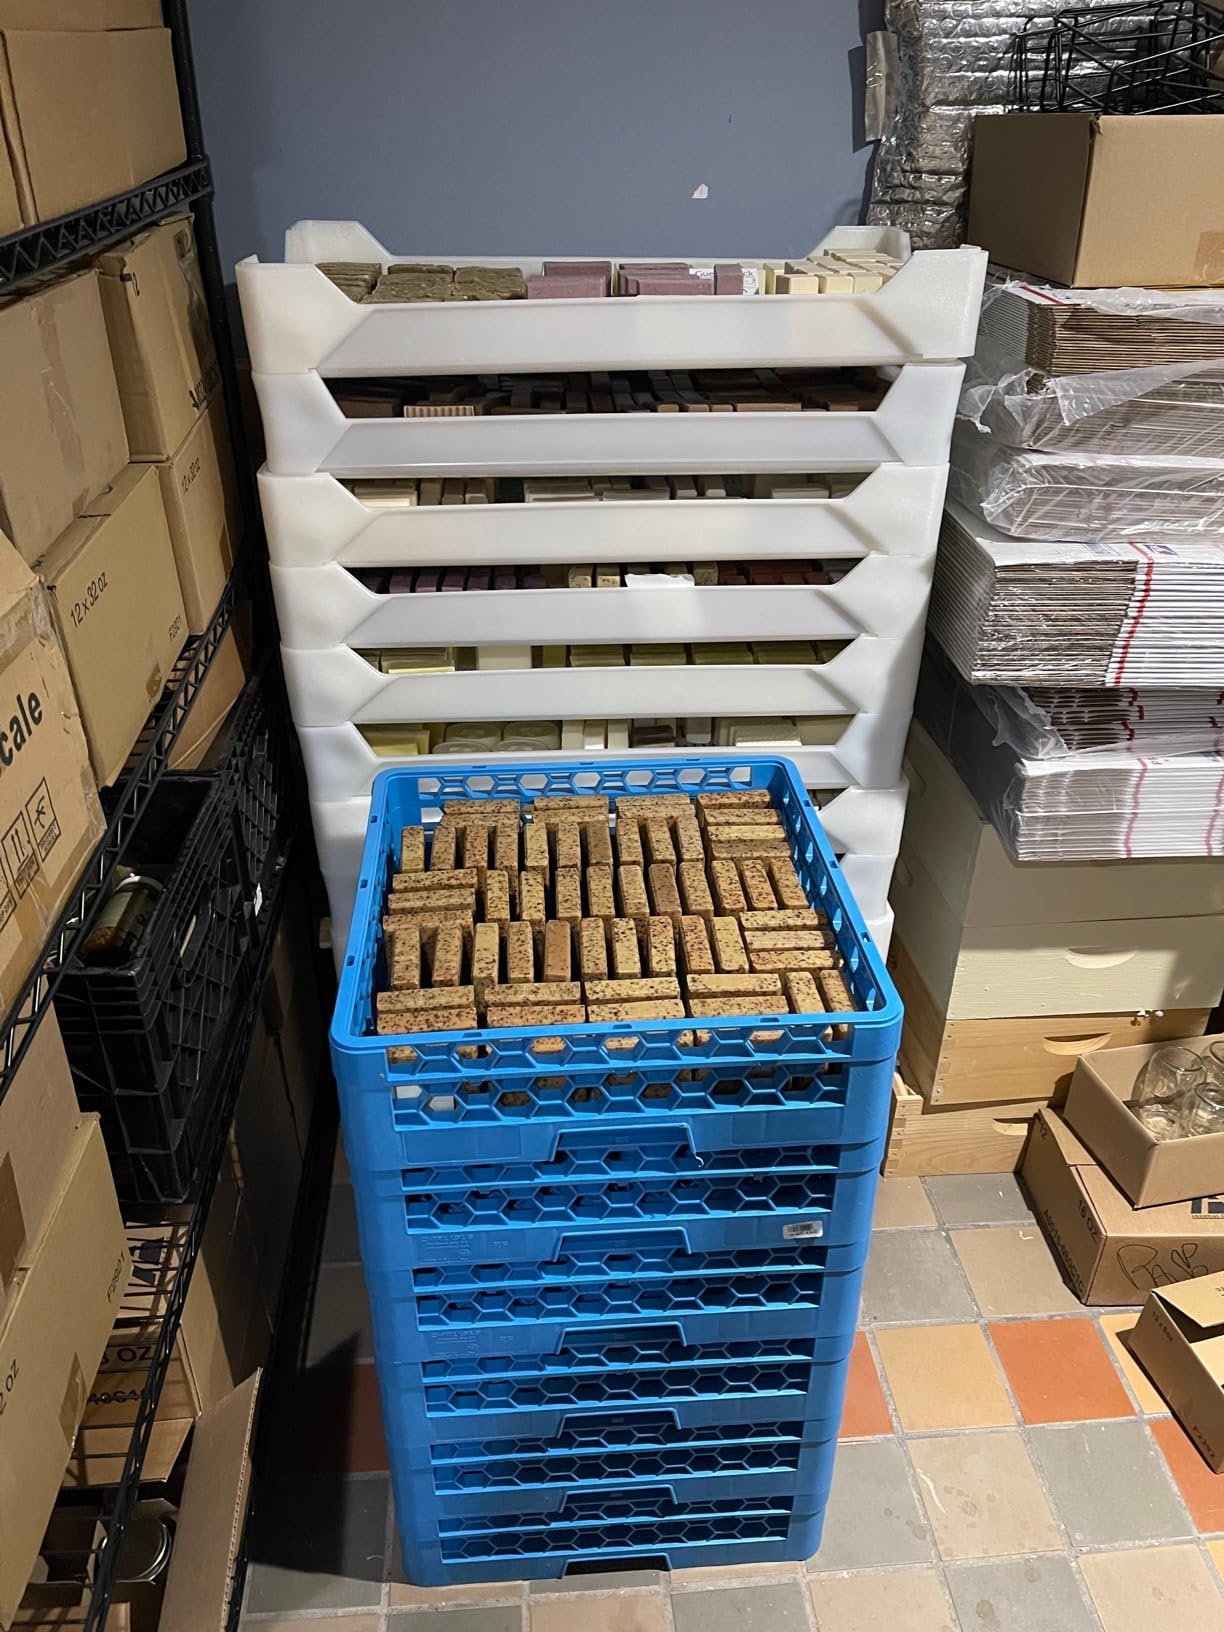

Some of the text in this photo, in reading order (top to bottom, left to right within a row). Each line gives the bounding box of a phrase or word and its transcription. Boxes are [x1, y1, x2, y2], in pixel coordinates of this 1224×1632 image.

[70, 602, 83, 629] 12
[81, 597, 90, 616] x
[87, 580, 99, 607] 32
[0, 691, 43, 767] cale
[116, 1345, 153, 1363] OZ
